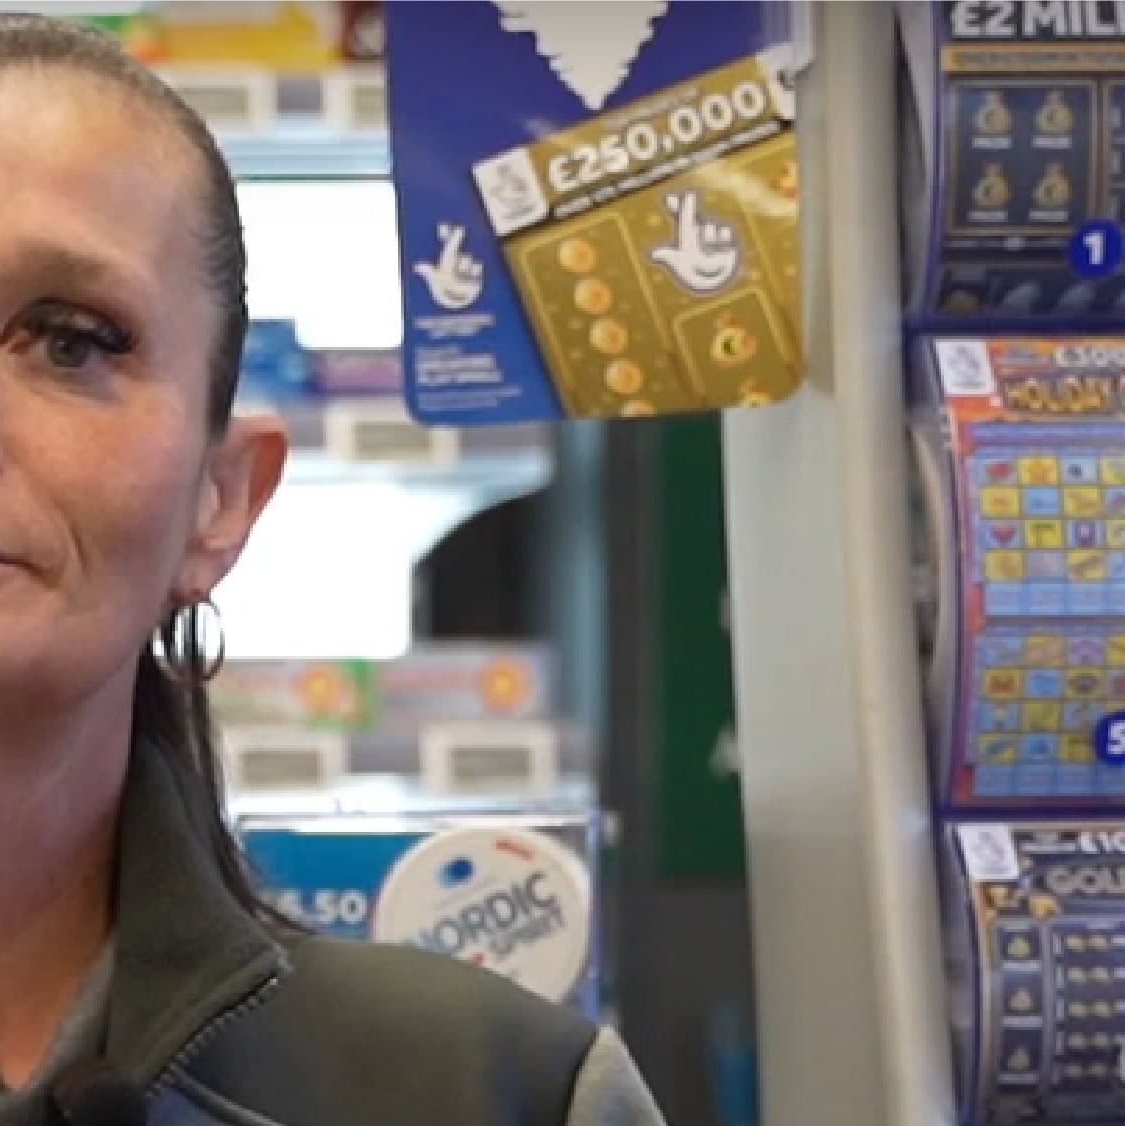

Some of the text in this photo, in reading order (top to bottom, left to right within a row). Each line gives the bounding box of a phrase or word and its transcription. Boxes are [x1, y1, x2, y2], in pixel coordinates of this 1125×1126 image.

[1023, 0, 1125, 37] MIL
[548, 80, 766, 194] £250,000
[1082, 232, 1106, 265] 1
